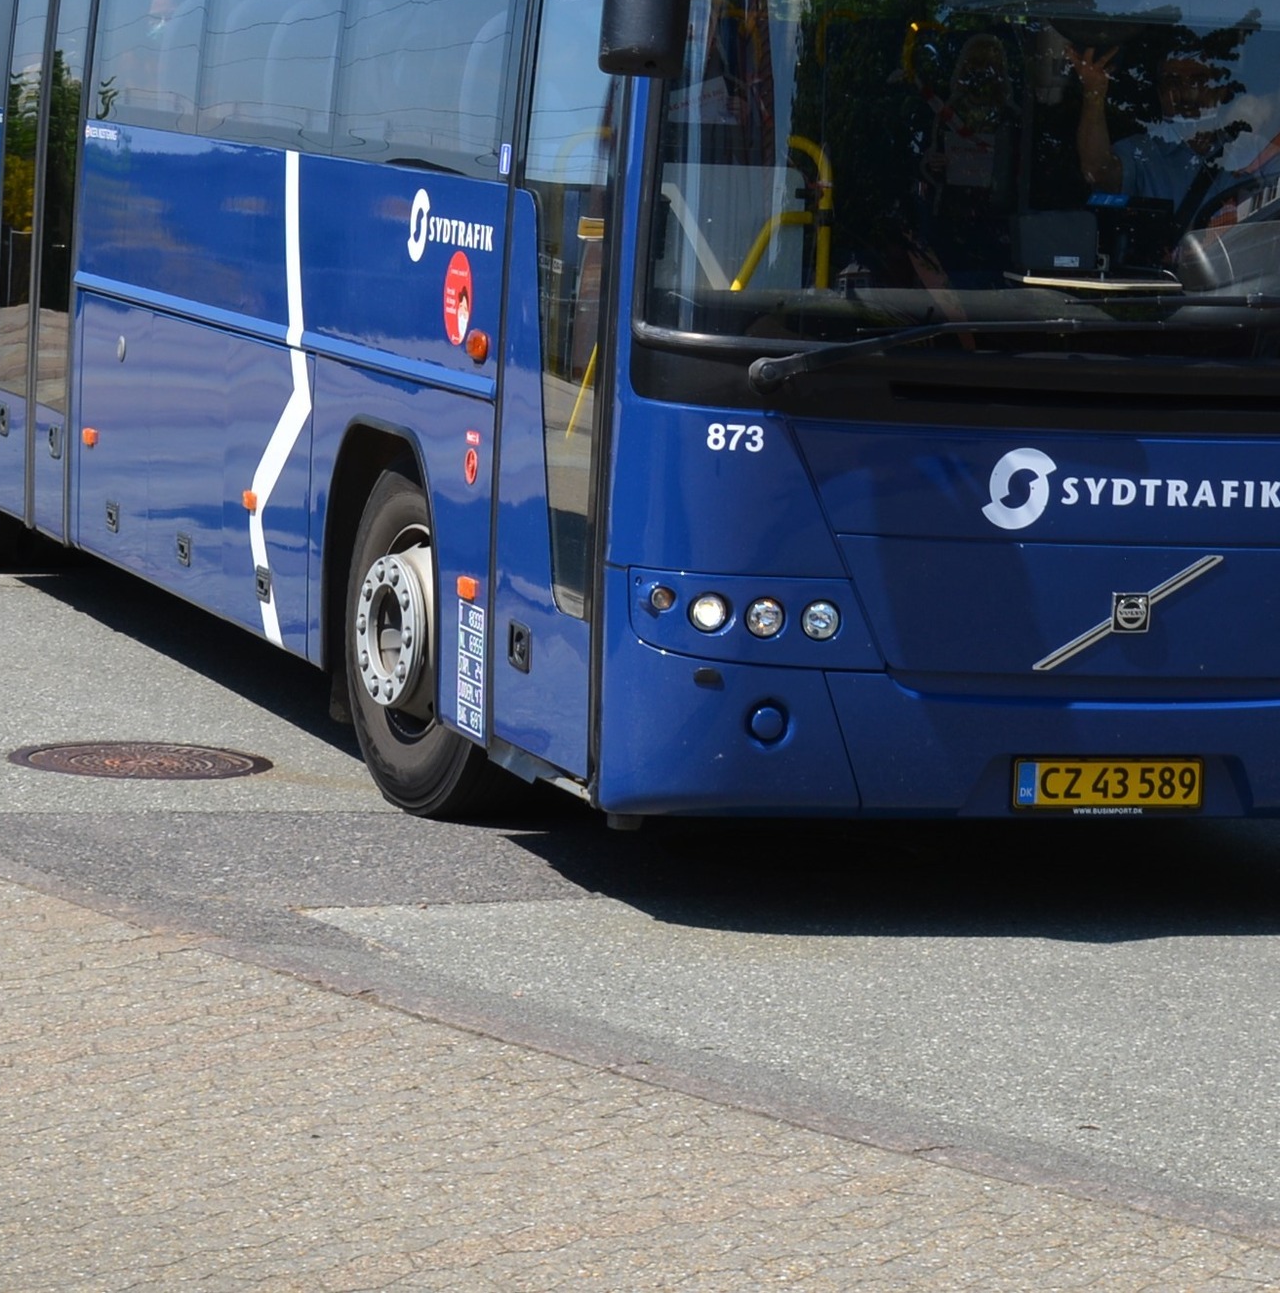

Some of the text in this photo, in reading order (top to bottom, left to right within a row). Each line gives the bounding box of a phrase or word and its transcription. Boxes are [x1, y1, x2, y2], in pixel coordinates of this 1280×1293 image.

[428, 216, 494, 252] SYDTRAFIK
[706, 422, 764, 453] 873
[1020, 787, 1033, 798] DK
[1040, 766, 1196, 800] CZ 43 589
[1072, 807, 1144, 815] WWW.BUSIMPORT.DK
